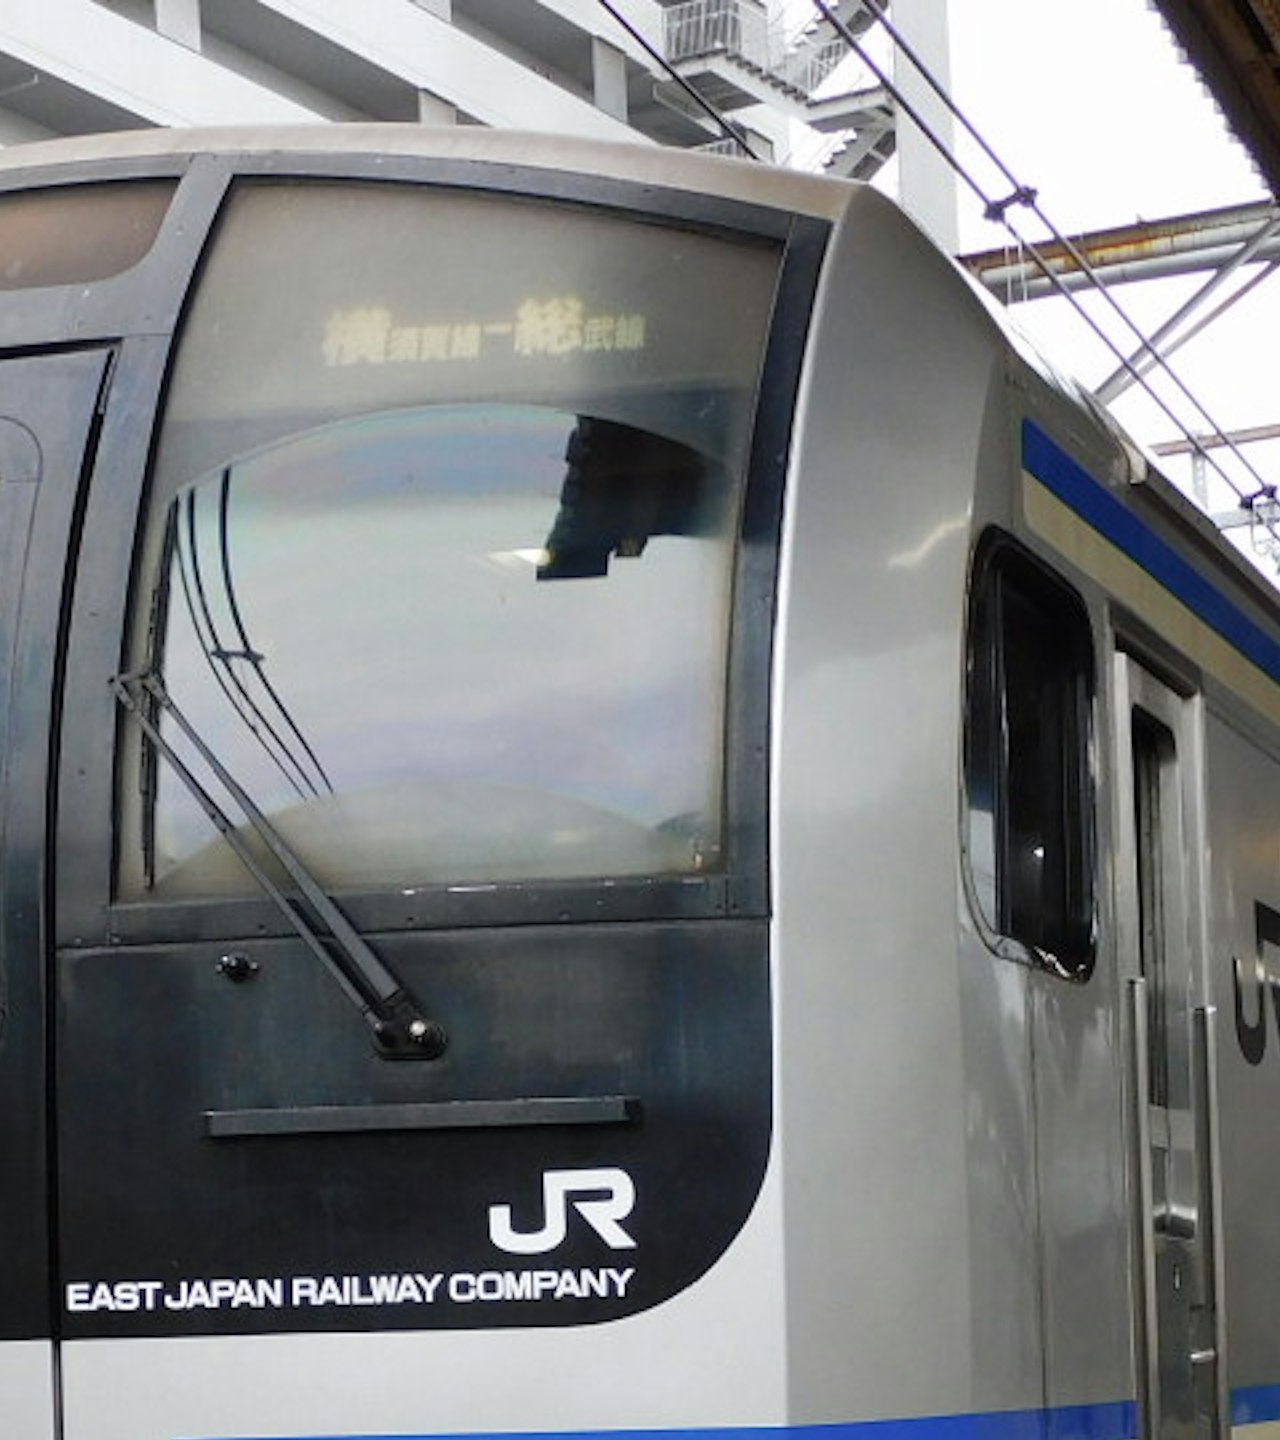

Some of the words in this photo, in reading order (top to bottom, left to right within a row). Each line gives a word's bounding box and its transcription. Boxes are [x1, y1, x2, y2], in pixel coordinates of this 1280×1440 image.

[489, 1167, 637, 1255] JR
[66, 1282, 163, 1313] EAST
[164, 1278, 283, 1312] JAPAN
[291, 1273, 445, 1307] RAILWAY
[448, 1267, 635, 1304] COMPANY
